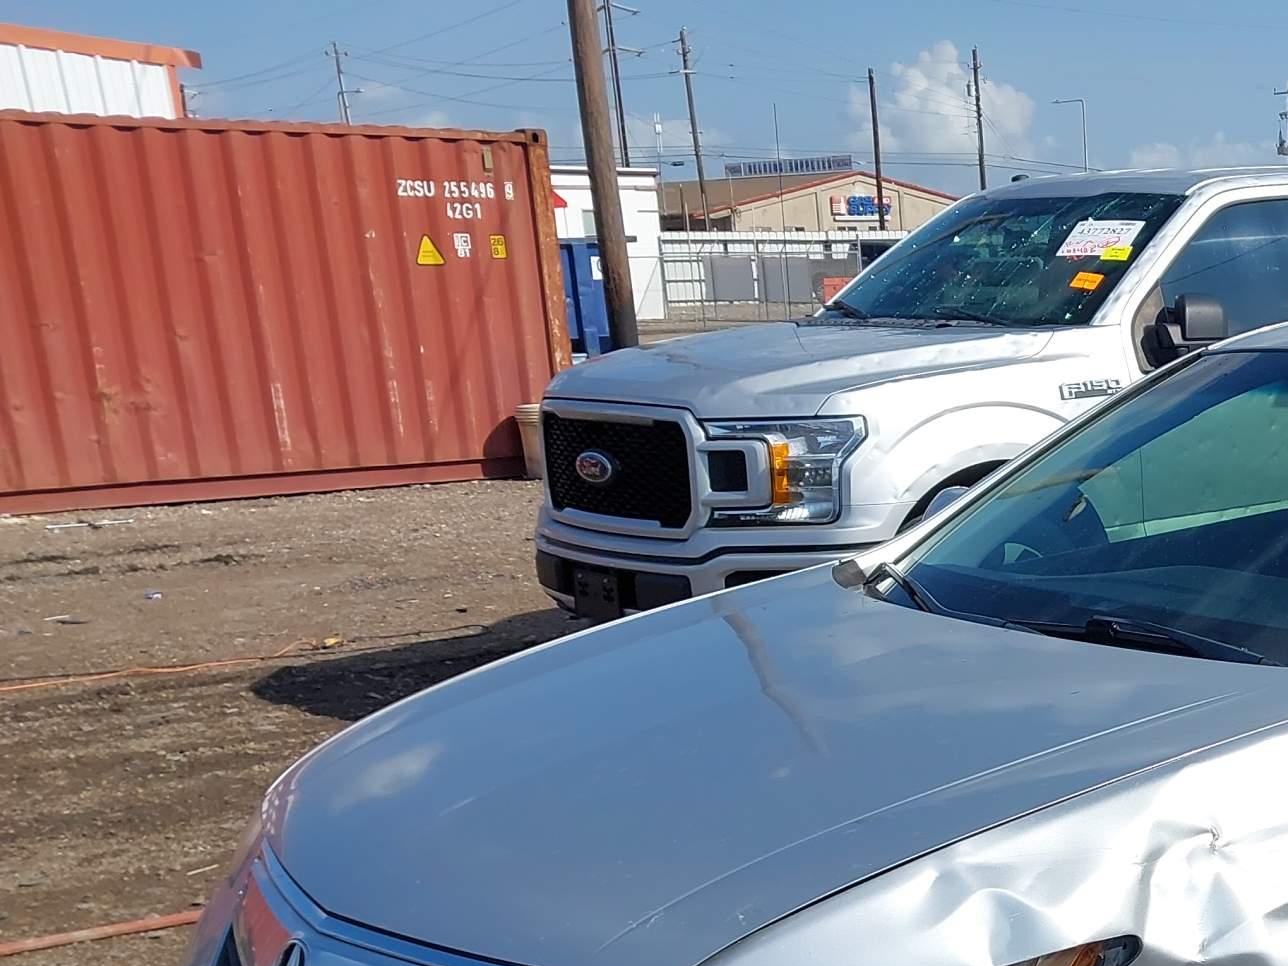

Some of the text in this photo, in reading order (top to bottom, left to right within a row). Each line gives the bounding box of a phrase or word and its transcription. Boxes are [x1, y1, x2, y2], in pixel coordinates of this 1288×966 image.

[396, 179, 435, 197] ZCSU
[443, 181, 496, 199] 255496
[447, 202, 482, 220] 42G1
